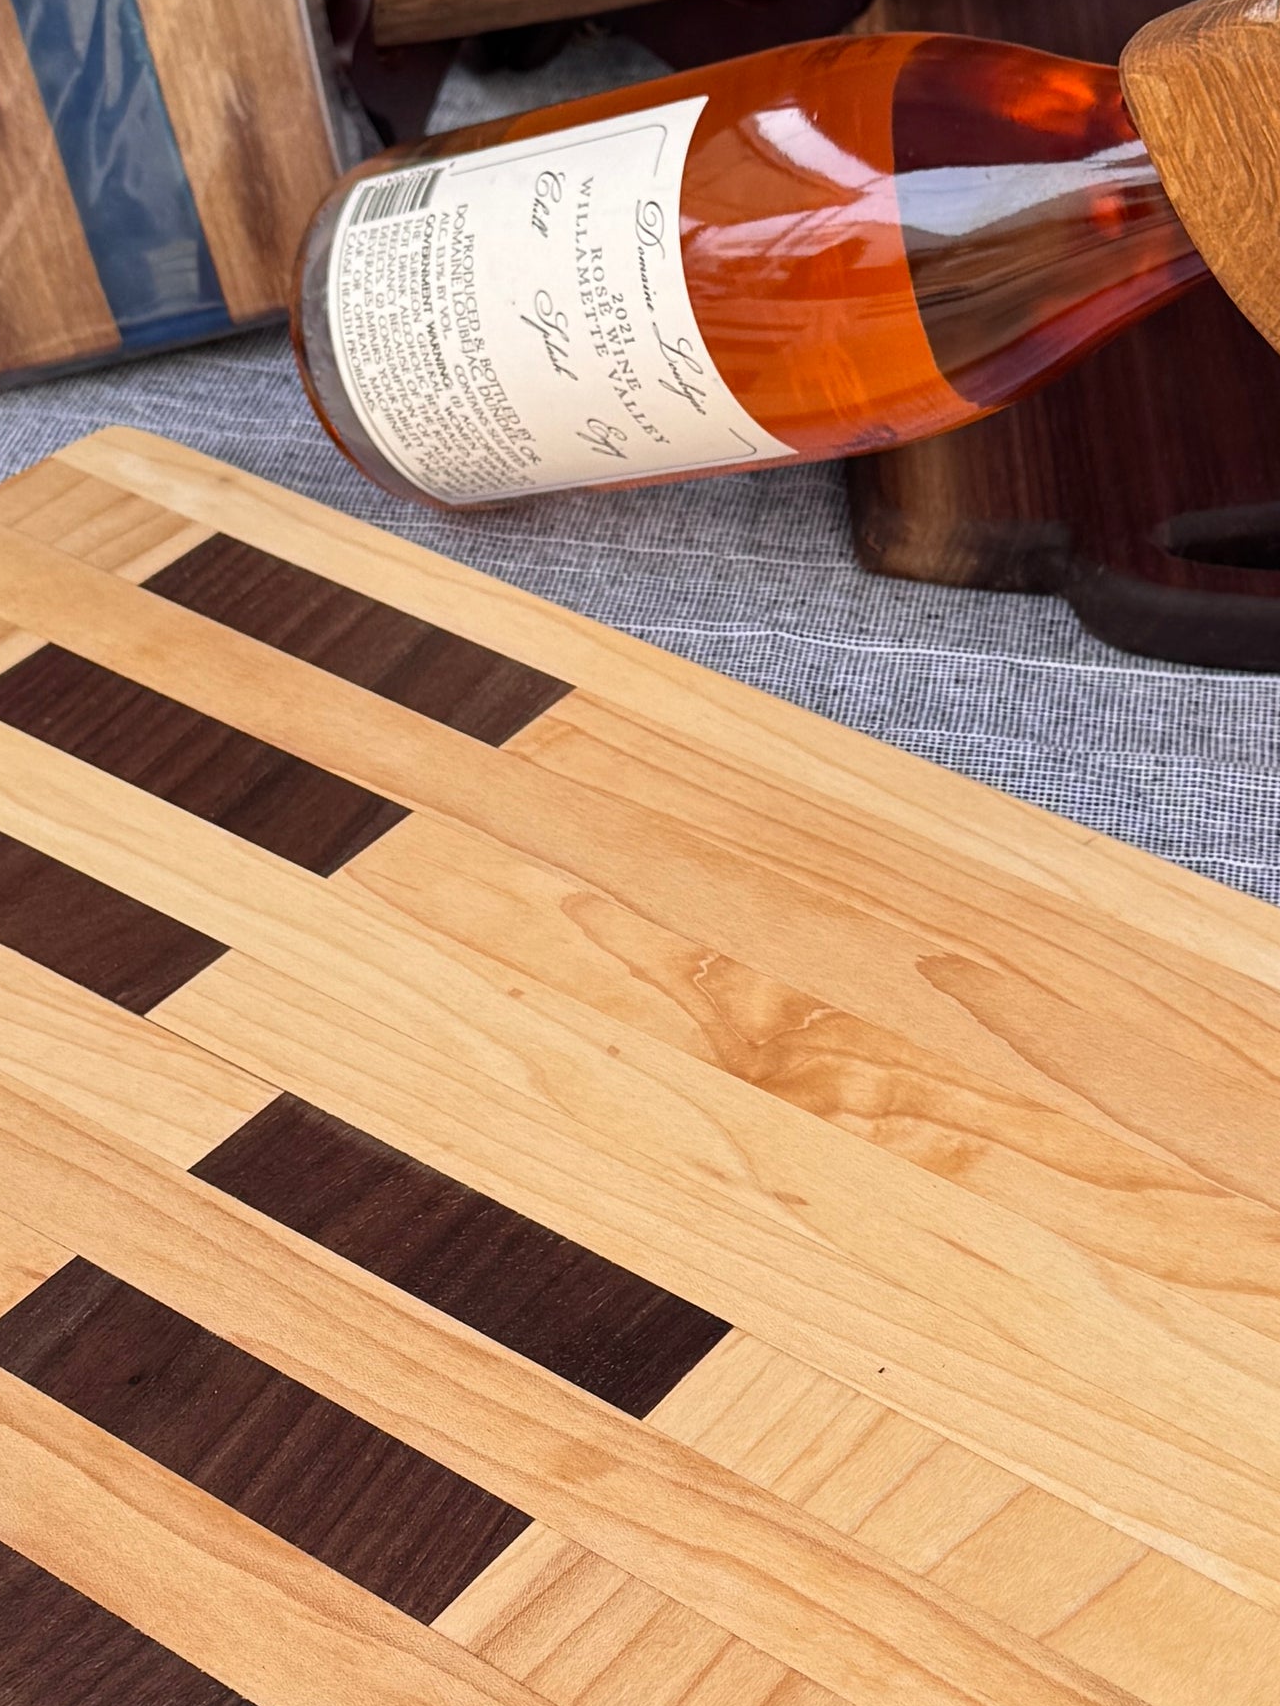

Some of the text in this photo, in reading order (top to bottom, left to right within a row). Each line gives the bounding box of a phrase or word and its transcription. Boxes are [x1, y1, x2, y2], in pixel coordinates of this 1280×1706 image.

[451, 204, 468, 287] DOMAINE
[531, 170, 566, 238] Chill
[410, 251, 422, 323] SURGEON
[421, 214, 436, 314] GOVERNMENT
[463, 234, 481, 332] PRODUCED
[635, 199, 665, 313] Domaine
[399, 305, 429, 389] ALCOHOLIC
[474, 337, 485, 353] &
[520, 289, 578, 381] Splash
[575, 176, 670, 444] WILLAMETTE VALLEY
[611, 293, 635, 344] 2021
[437, 285, 447, 301] BY
[454, 364, 489, 427] CONTAINS
[479, 358, 520, 425] BOTTLED
[606, 327, 642, 391] WINE
